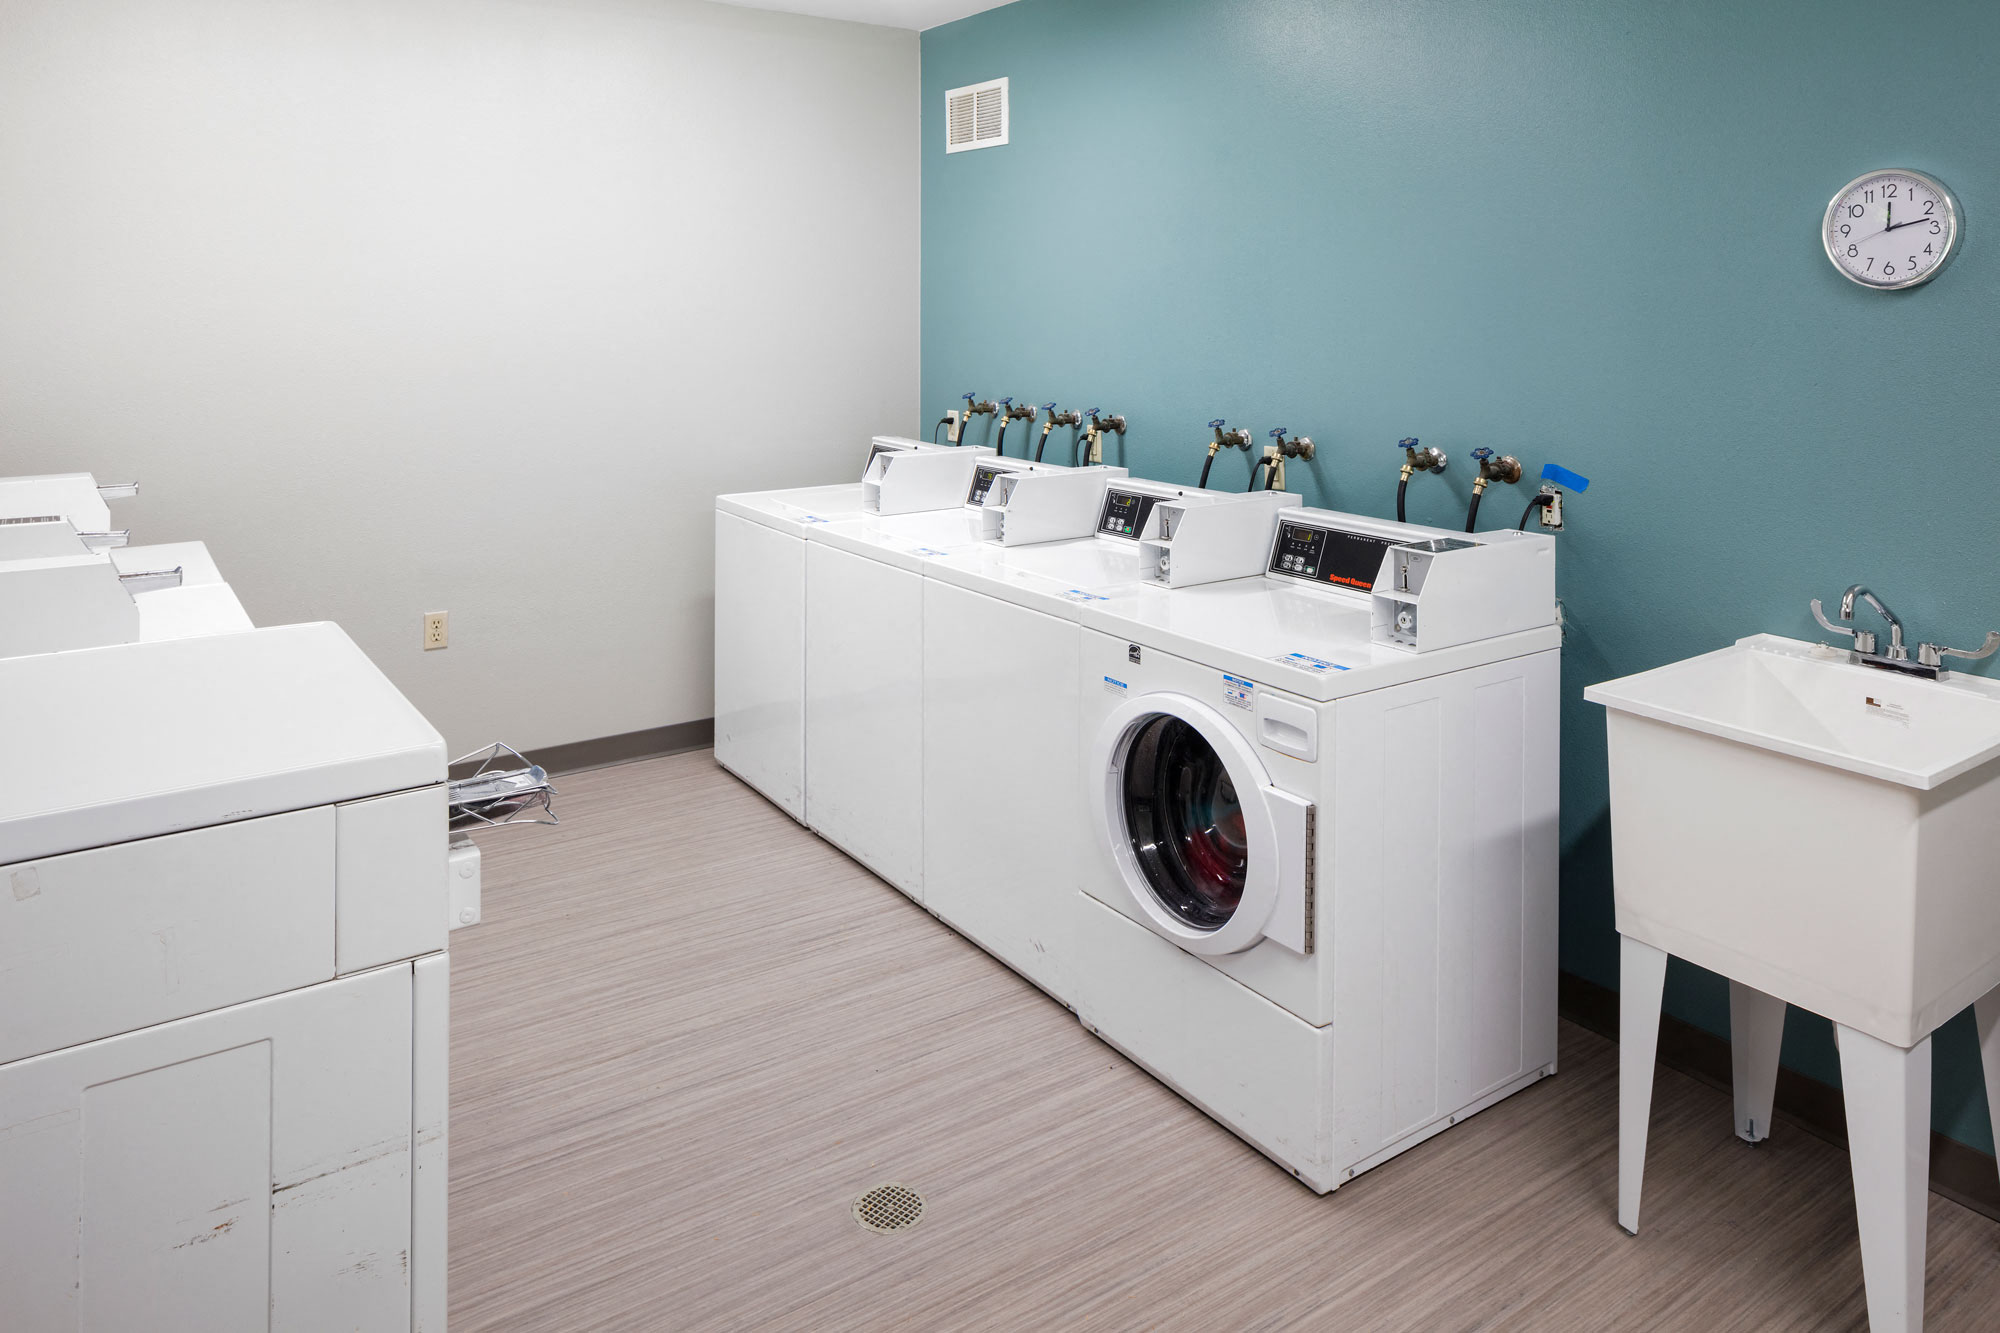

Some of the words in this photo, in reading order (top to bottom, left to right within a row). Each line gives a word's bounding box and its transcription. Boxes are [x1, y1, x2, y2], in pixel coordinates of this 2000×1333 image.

[1864, 190, 1874, 203] 11
[1881, 183, 1897, 198] 12
[1908, 187, 1913, 201] 1
[1847, 204, 1864, 218] 10
[1923, 200, 1934, 215] 2
[1840, 224, 1851, 238] 9
[1929, 220, 1941, 235] 3
[1847, 243, 1858, 258] 8
[1923, 242, 1933, 256] 4
[1866, 257, 1874, 271] 7
[1883, 261, 1895, 275] 6
[1907, 256, 1917, 270] 5
[1329, 573, 1350, 584] Speed
[1350, 577, 1372, 588] Queen
